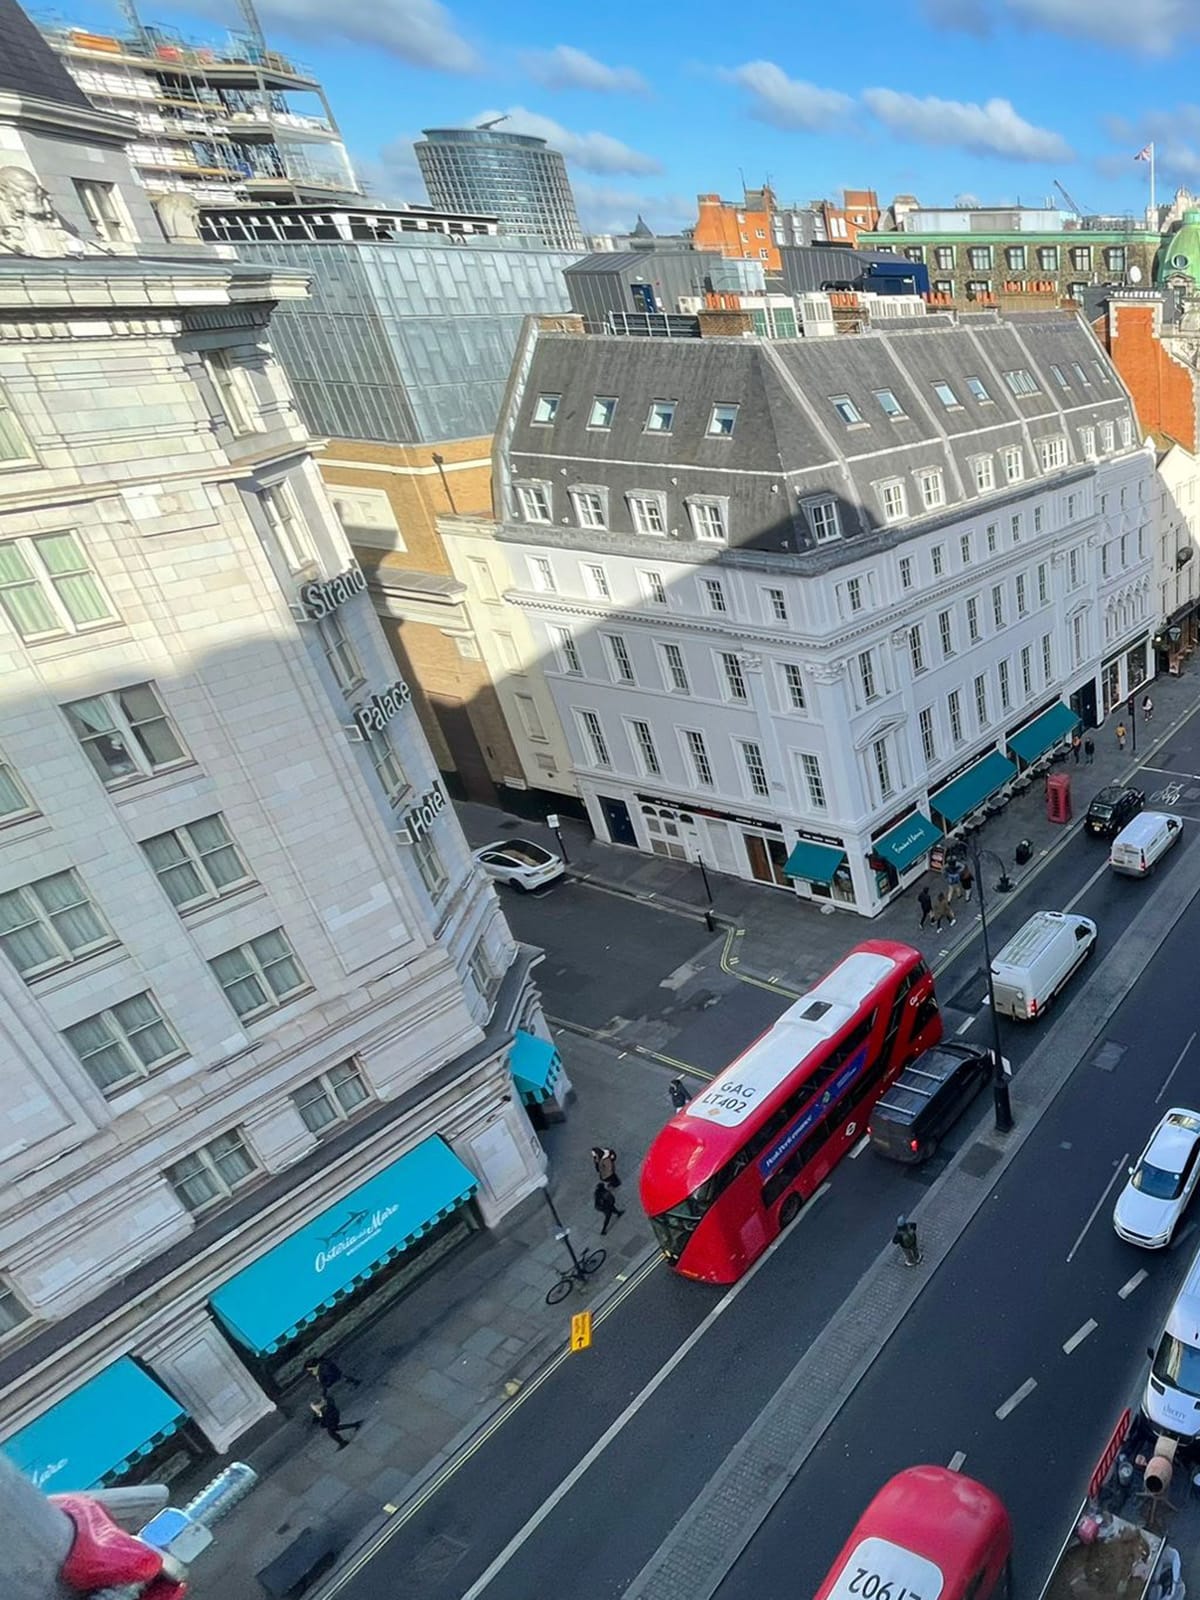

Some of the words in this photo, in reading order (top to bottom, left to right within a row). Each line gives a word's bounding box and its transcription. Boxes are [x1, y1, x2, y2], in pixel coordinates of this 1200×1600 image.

[306, 562, 368, 620] Strand
[359, 682, 411, 740] Palace
[410, 780, 447, 841] Hotel
[702, 1093, 747, 1113] LT402
[721, 1081, 756, 1098] GAG
